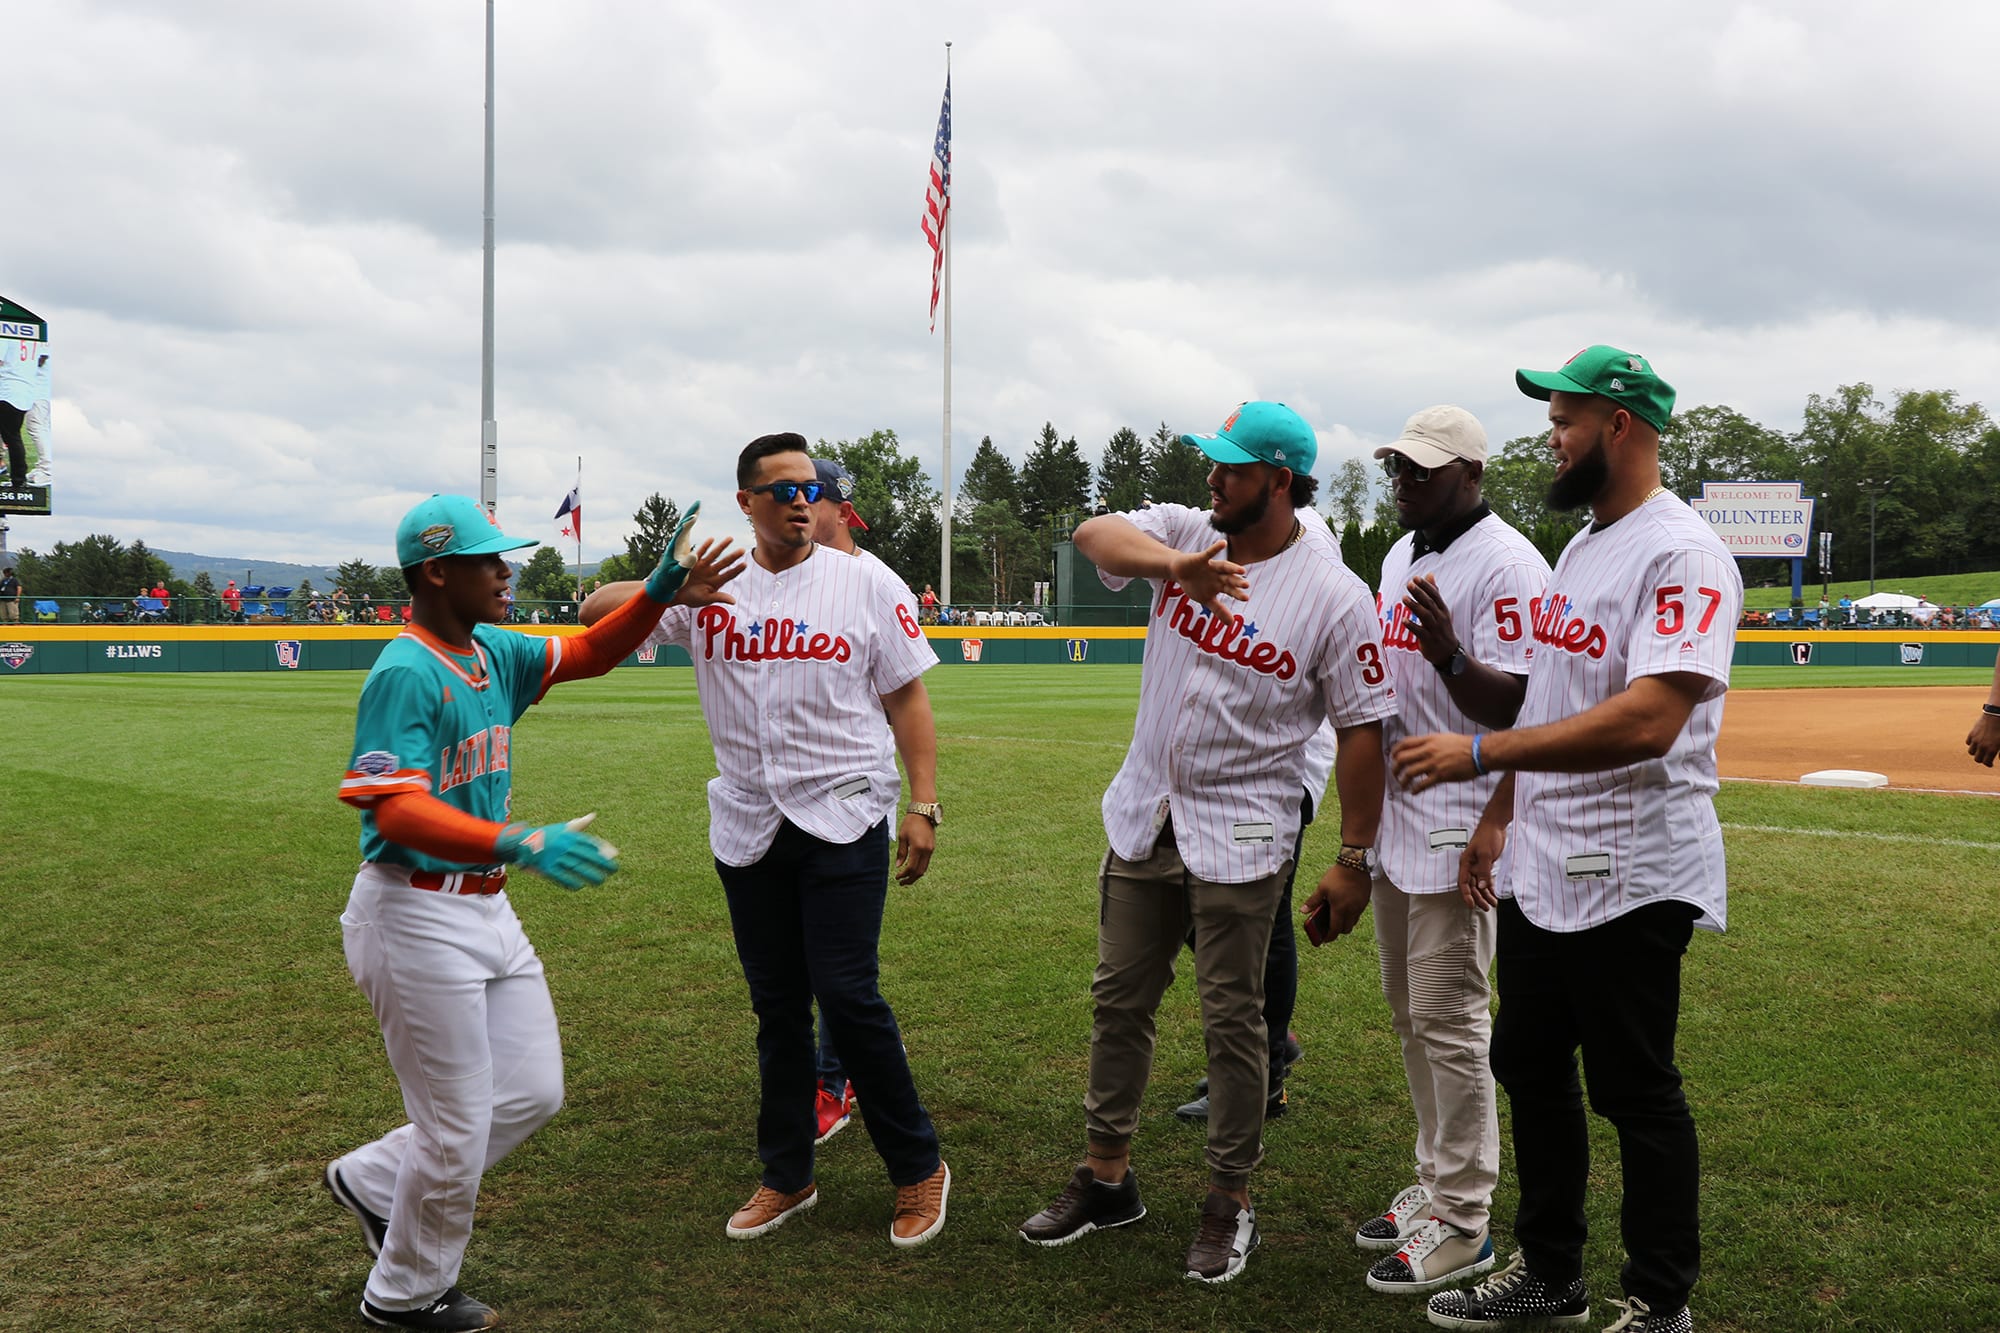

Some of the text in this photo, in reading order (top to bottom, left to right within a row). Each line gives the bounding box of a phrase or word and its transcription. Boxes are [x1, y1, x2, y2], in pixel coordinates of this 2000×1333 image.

[0, 323, 34, 337] NS
[17, 492, 33, 502] PM
[1711, 491, 1793, 500] WELCOME TO
[1699, 510, 1804, 525] VOLUNTEER
[1721, 535, 1782, 545] STADIUM
[1655, 584, 1722, 636] 57
[895, 603, 920, 640] 6
[1494, 597, 1523, 642] 5
[696, 604, 852, 664] Phillies
[106, 645, 162, 658] #LLWS
[1356, 642, 1386, 686] 3
